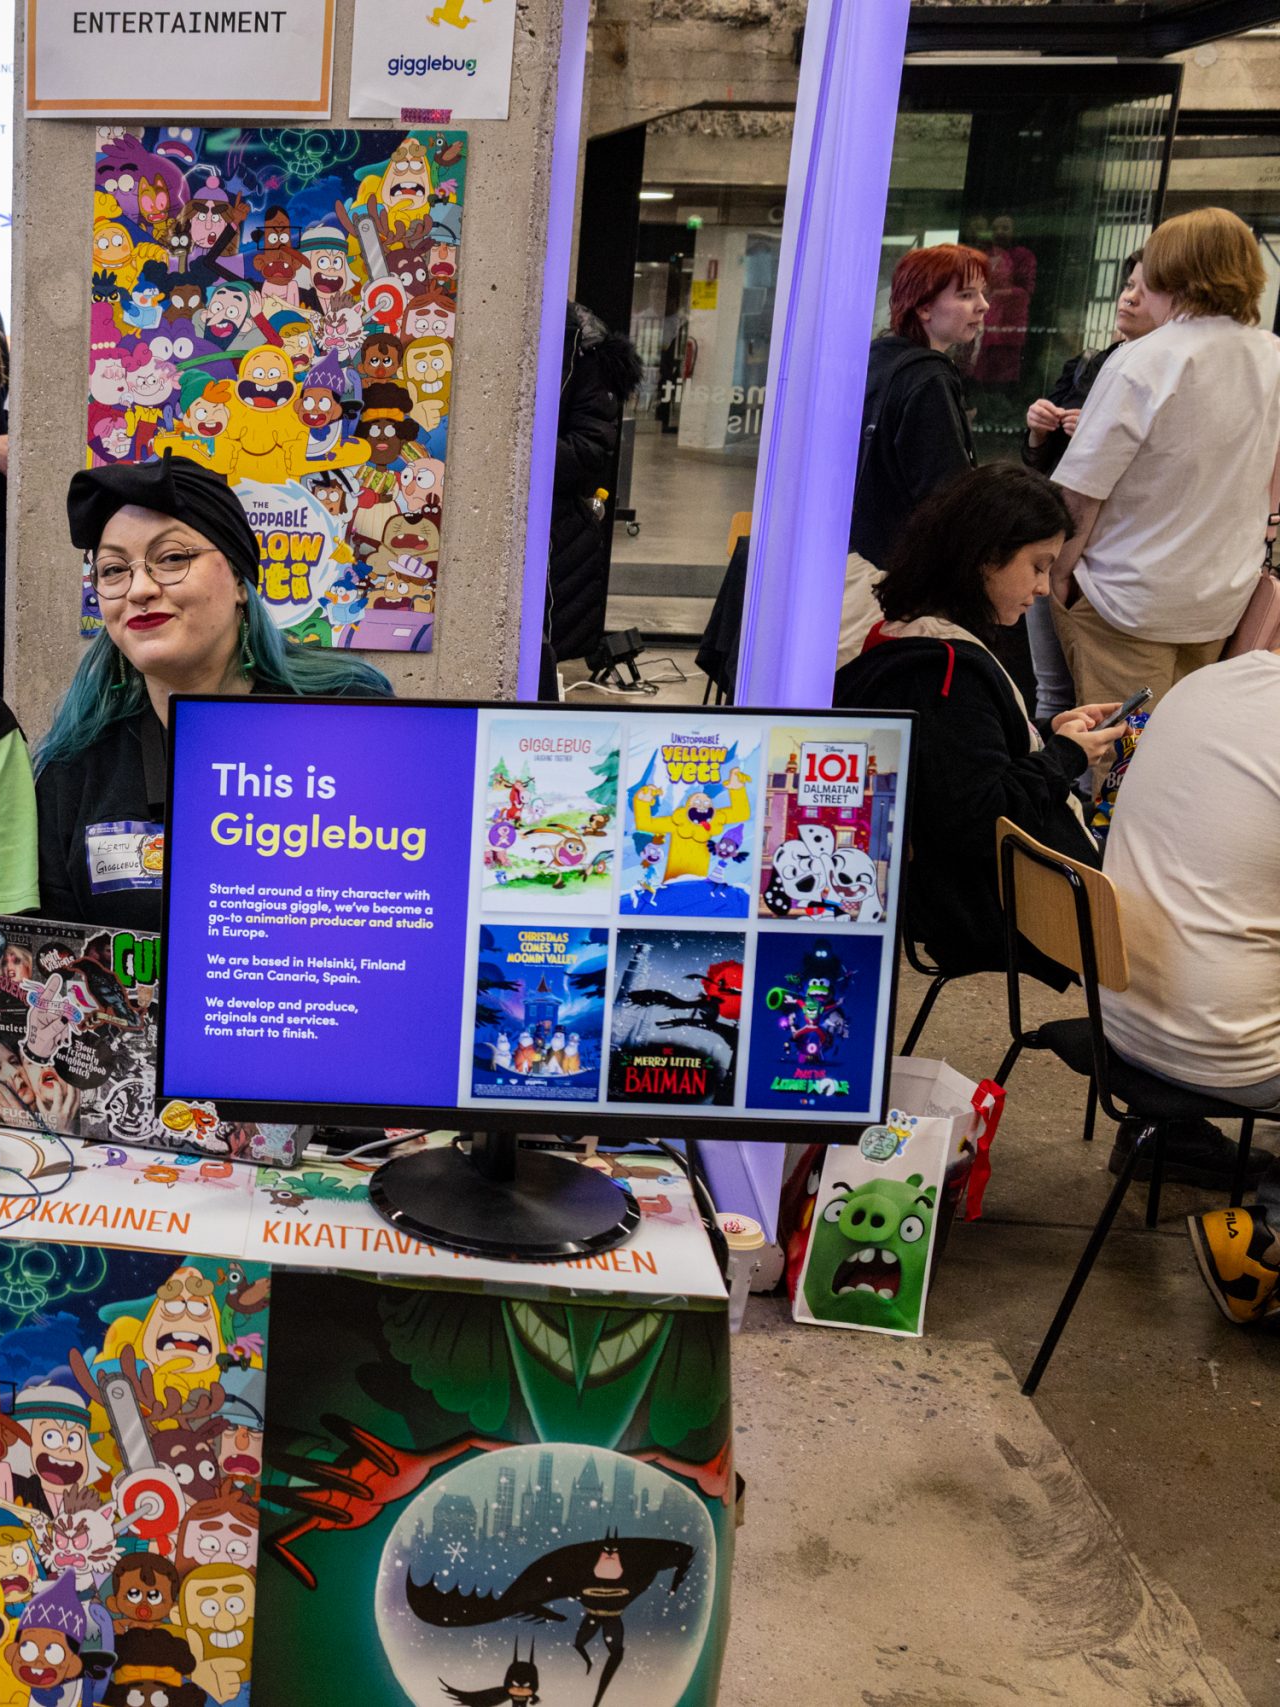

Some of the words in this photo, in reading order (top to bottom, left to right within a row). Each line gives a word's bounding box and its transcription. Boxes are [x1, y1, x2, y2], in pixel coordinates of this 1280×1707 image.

[73, 11, 287, 34] ENTERTAINMENT
[388, 54, 477, 76] gigglebug
[253, 501, 269, 509] THE
[246, 506, 308, 528] OPPABLE
[254, 530, 324, 563] LOW
[519, 738, 592, 753] GIGGLEBUG
[671, 733, 720, 744] UNSTOPPABLE
[661, 745, 727, 763] YELLOW
[804, 753, 859, 782] 101
[211, 762, 293, 798] This
[306, 766, 336, 799] is
[803, 784, 859, 794] DALMATIAN
[813, 794, 848, 804] STREET
[210, 812, 427, 861] Gigglebug
[209, 883, 255, 896] Started
[257, 886, 302, 897] around
[305, 889, 314, 897] a
[316, 887, 338, 900] tiny
[341, 888, 401, 900] character
[404, 889, 431, 901] with
[209, 900, 218, 909] a
[220, 899, 287, 912] contagious
[290, 901, 332, 914] giggle,
[373, 903, 422, 915] become
[425, 906, 433, 915] a
[208, 914, 243, 925] go-to
[246, 914, 307, 925] animation
[310, 916, 366, 928] producer
[369, 917, 393, 928] and
[396, 918, 434, 929] studio
[208, 926, 219, 936] in
[223, 927, 269, 940] Europe.
[518, 931, 569, 943] CHRISTMAS
[520, 942, 551, 953] COMES
[553, 943, 566, 953] TO
[207, 954, 226, 965] We
[229, 957, 250, 966] are
[252, 955, 290, 967] based
[293, 957, 304, 967] in
[307, 957, 357, 971] Helsinki,
[360, 959, 406, 971] Finland
[206, 969, 230, 979] and
[233, 970, 264, 981] Gran
[267, 971, 320, 984] Canaria,
[322, 972, 361, 986] Spain.
[205, 996, 224, 1007] We
[227, 997, 275, 1011] develop
[278, 1000, 302, 1010] and
[305, 1001, 359, 1014] produce,
[204, 1012, 257, 1025] originals
[260, 1014, 284, 1024] and
[287, 1015, 339, 1026] services.
[204, 1025, 233, 1036] from
[236, 1027, 264, 1038] start
[267, 1028, 279, 1038] to
[282, 1028, 318, 1039] finish.
[633, 1056, 667, 1067] MERRY
[670, 1057, 701, 1068] LITTLE
[625, 1066, 707, 1095] BATMAN
[1224, 1211, 1239, 1239] FILA
